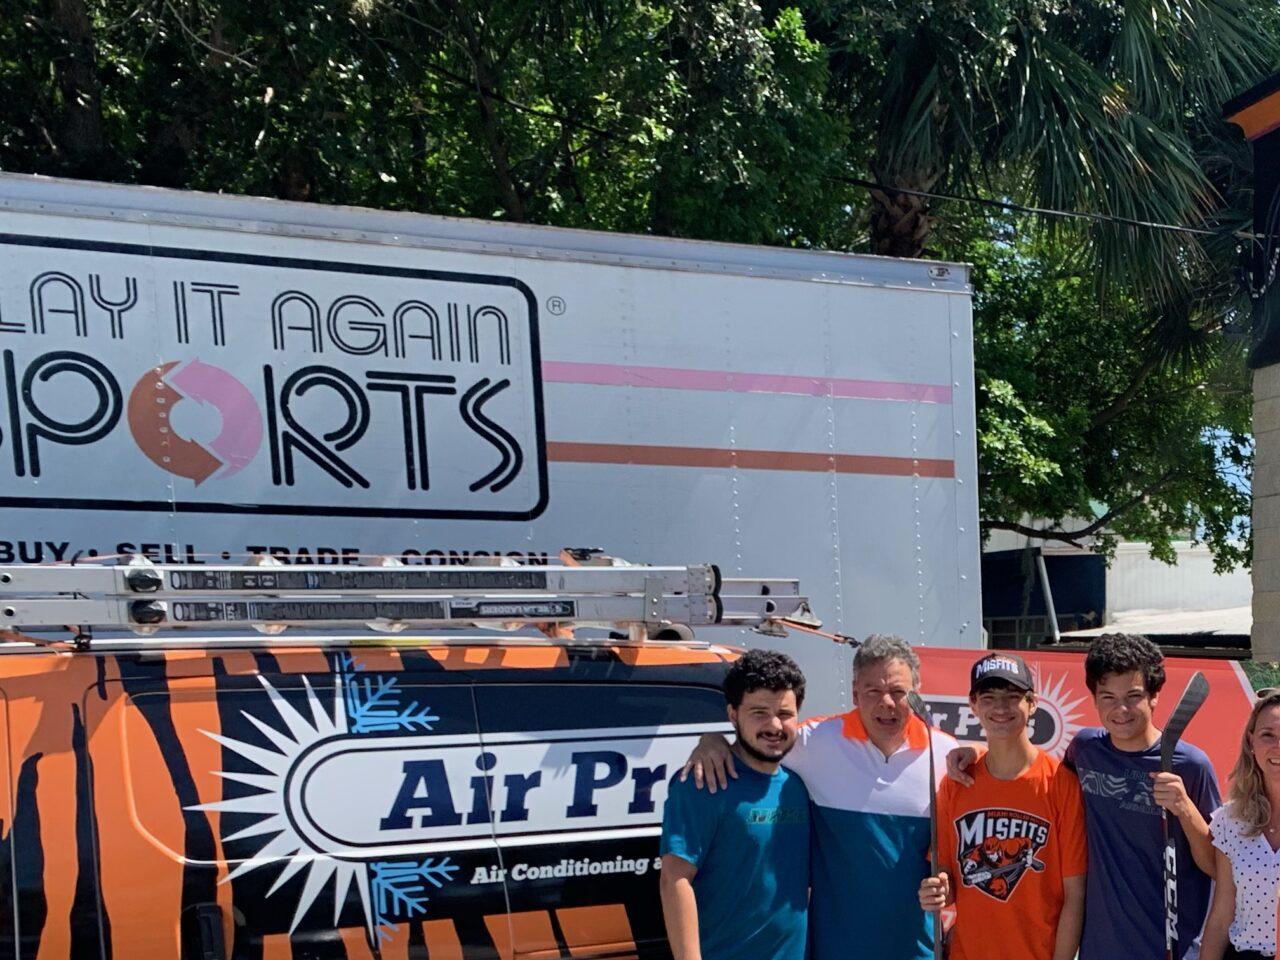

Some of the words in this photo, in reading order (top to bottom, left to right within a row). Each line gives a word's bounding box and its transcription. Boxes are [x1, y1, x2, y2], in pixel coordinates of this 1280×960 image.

[173, 281, 239, 346] IT
[271, 289, 511, 365] AGAIN
[0, 349, 524, 493] PORTS
[0, 541, 69, 564] BUY
[116, 542, 205, 564] SELL
[246, 546, 360, 565] TRADE
[975, 658, 1019, 679] MISFITS
[925, 704, 948, 732] ir
[379, 751, 542, 831] Air
[566, 750, 677, 818] Pr
[960, 812, 1048, 856] MISFITS
[470, 864, 507, 884] Air
[511, 856, 650, 882] Conditioning
